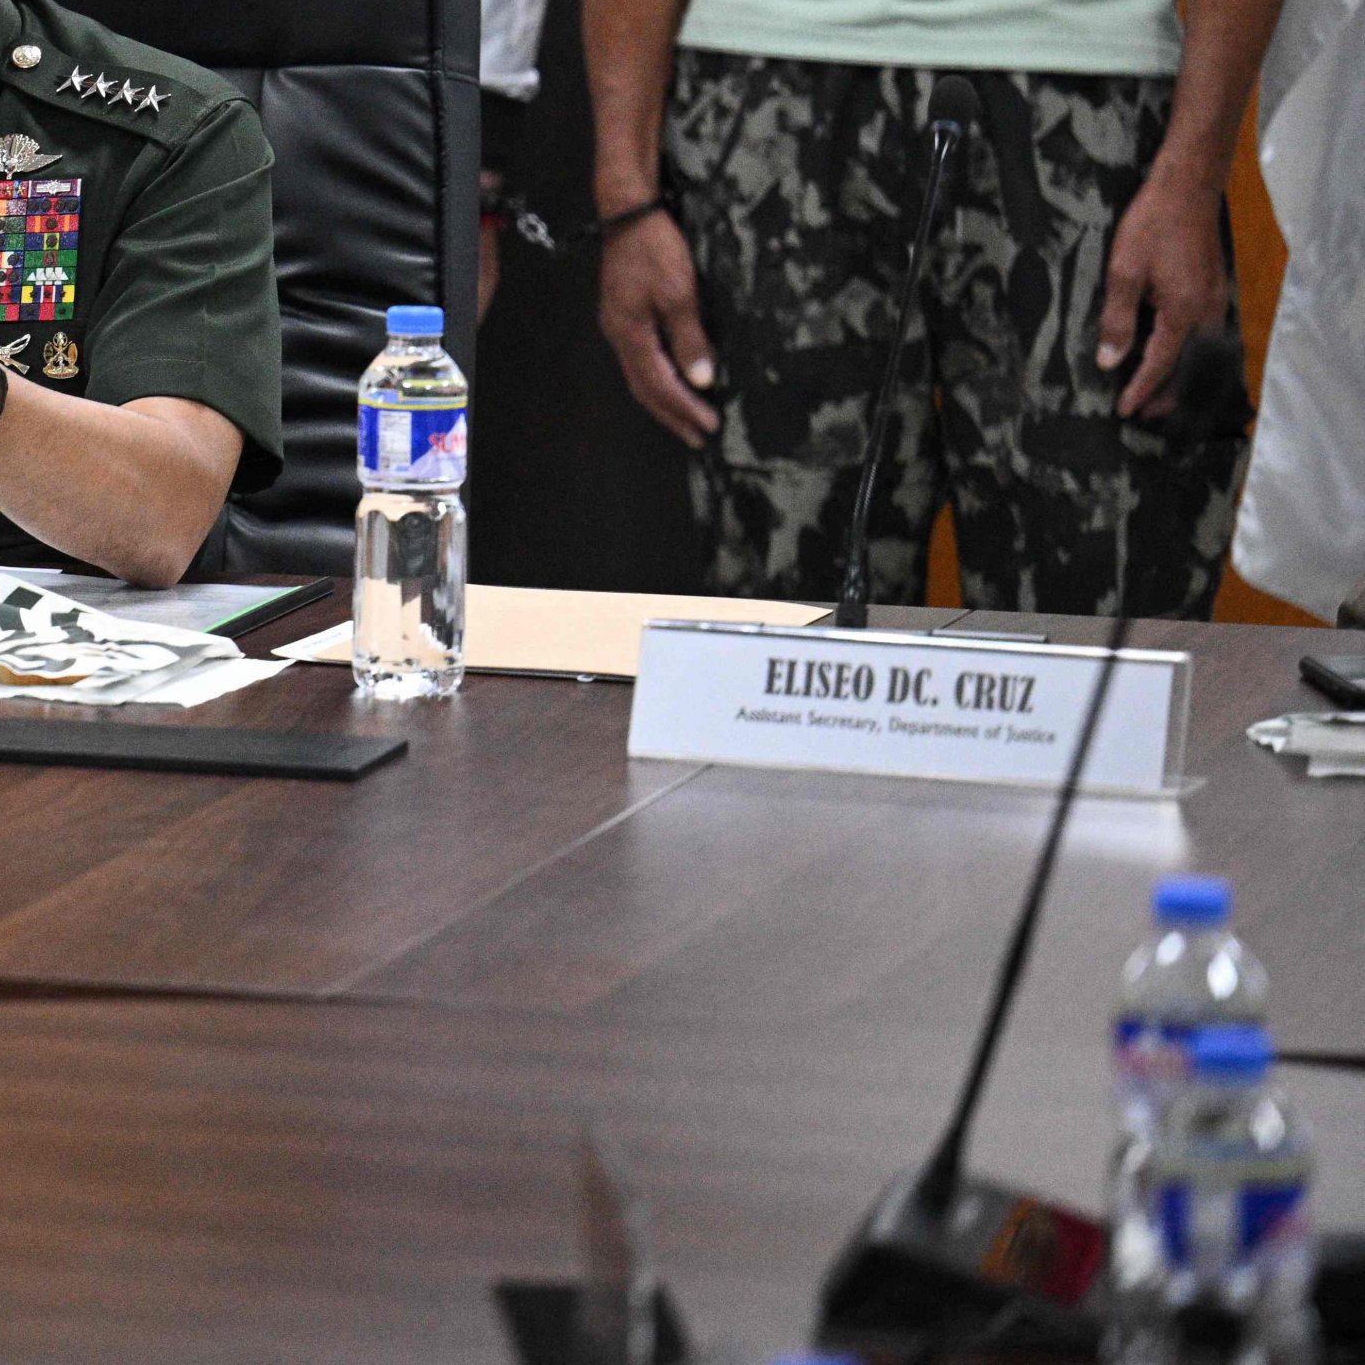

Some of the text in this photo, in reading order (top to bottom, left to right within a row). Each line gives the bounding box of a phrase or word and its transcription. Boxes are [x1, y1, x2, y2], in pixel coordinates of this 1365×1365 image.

[764, 657, 1037, 714] ELISEO DC. CRUZ
[735, 706, 1056, 745] Assistant Secretary, Department of Justice
